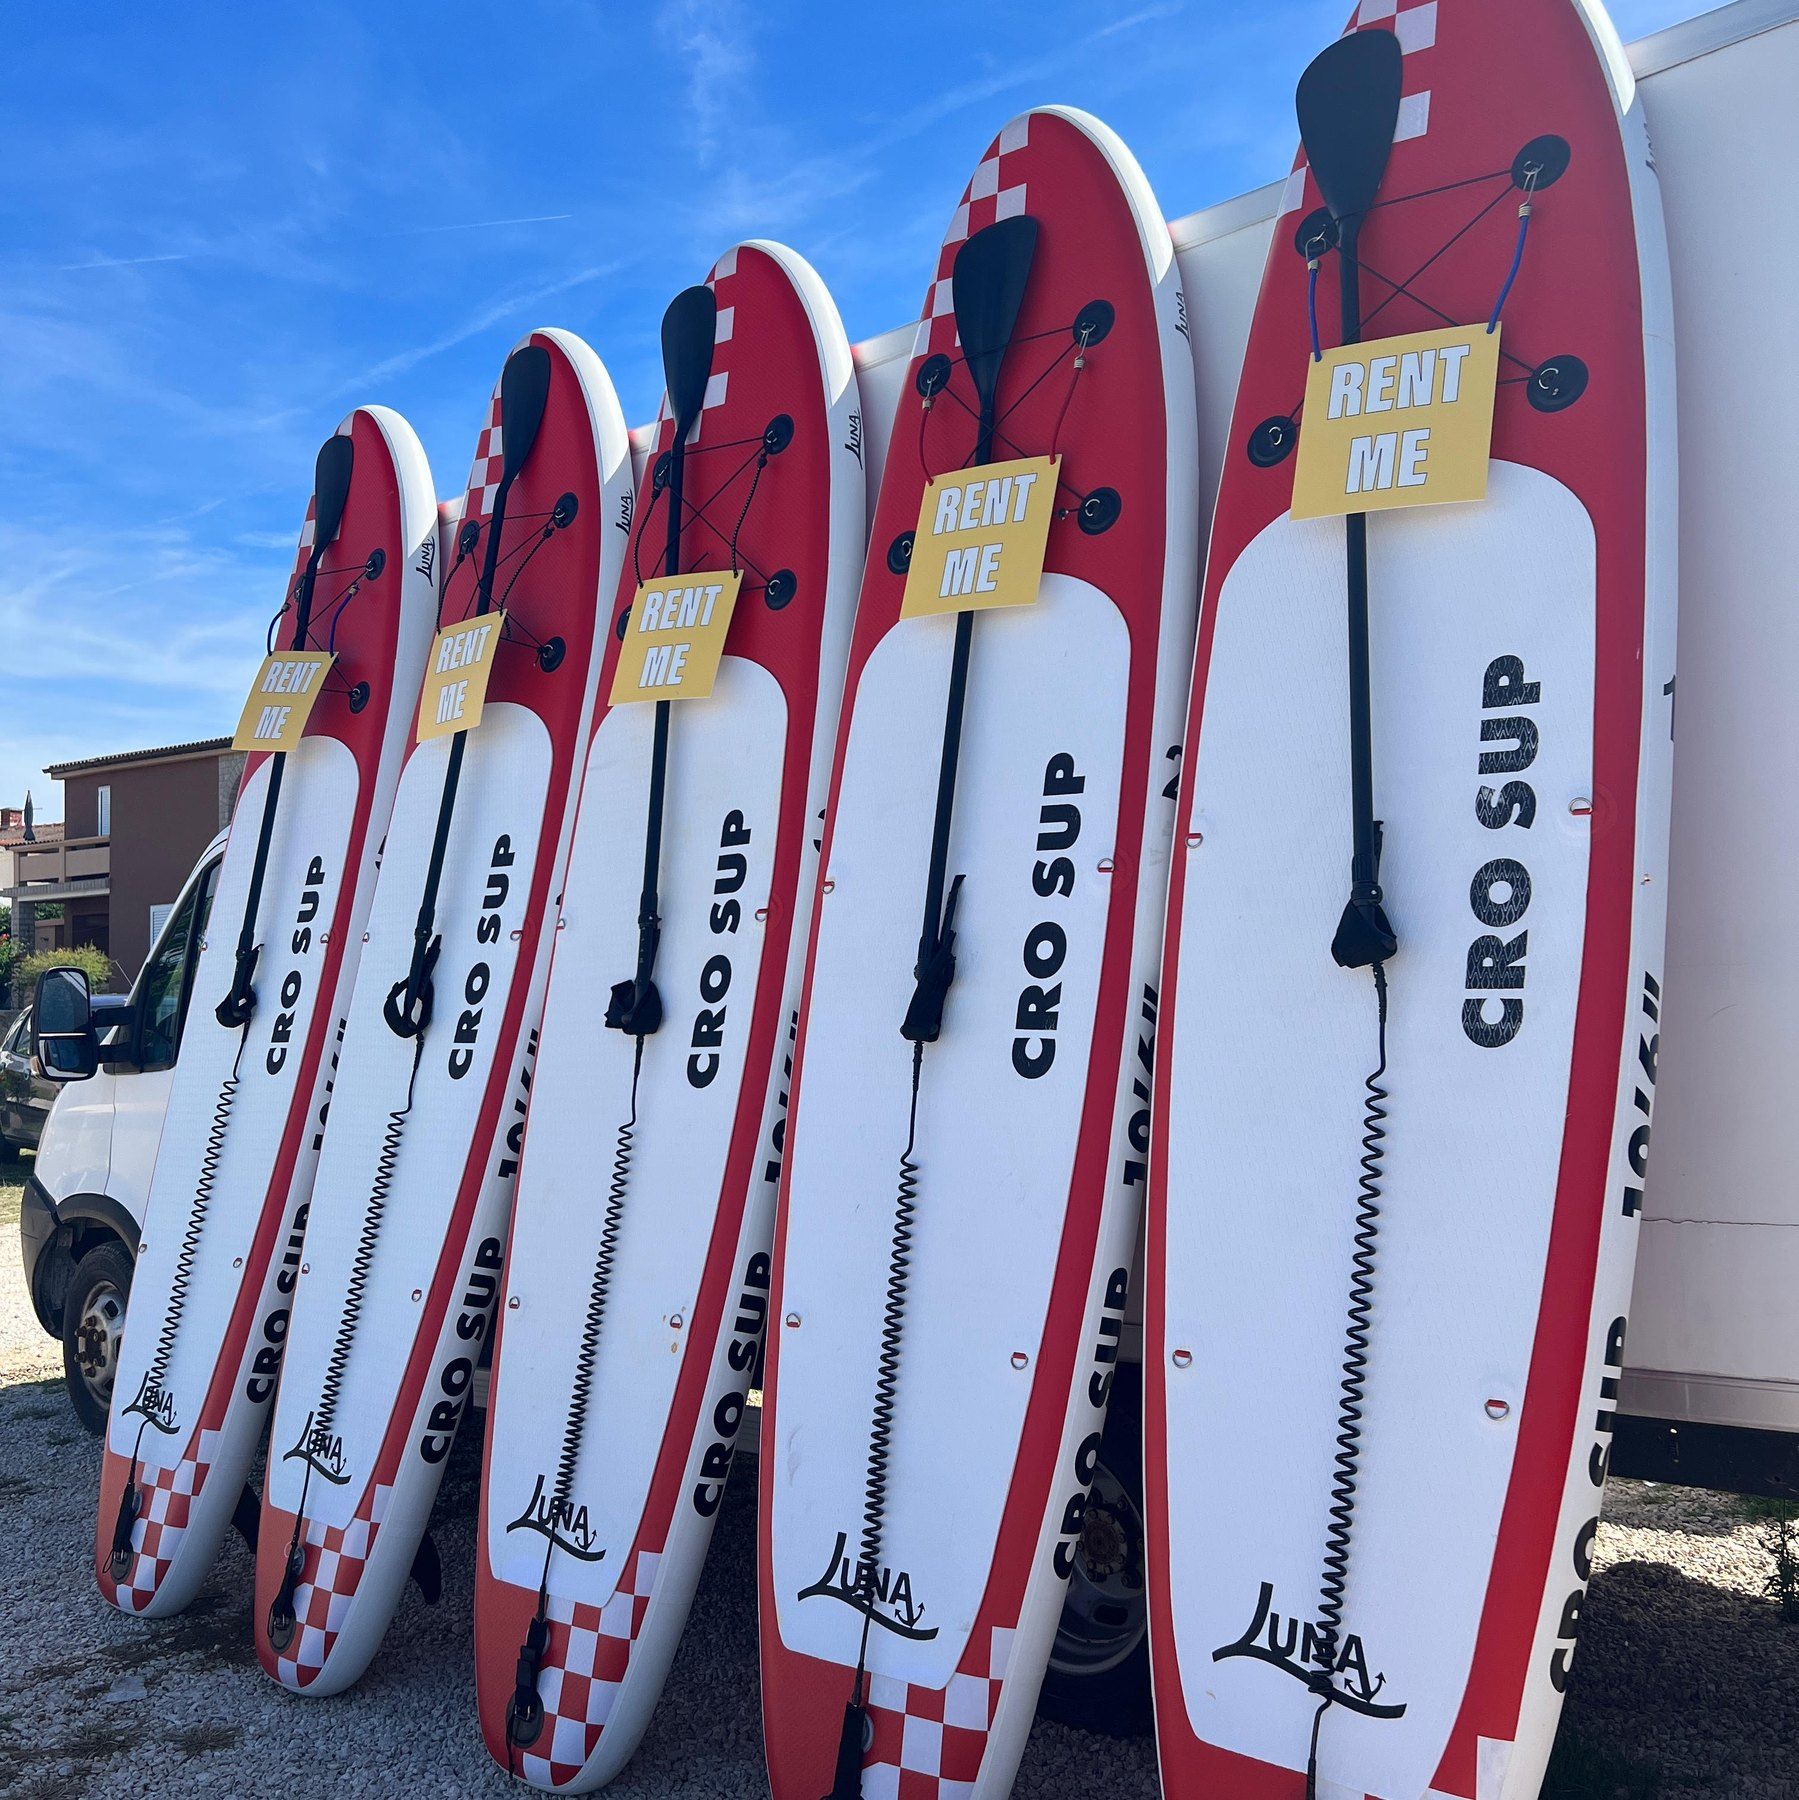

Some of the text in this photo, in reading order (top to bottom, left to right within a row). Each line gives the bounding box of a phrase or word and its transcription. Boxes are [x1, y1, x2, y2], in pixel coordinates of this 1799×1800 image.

[1327, 344, 1470, 420] RENT
[844, 406, 863, 471] LUNA
[1345, 428, 1431, 494] ME
[615, 488, 634, 537] LUNA
[932, 473, 1038, 536] RENT
[415, 535, 436, 588] LUNA
[939, 543, 1003, 598] ME
[638, 584, 724, 633] RENT
[260, 660, 322, 694] RENT
[435, 624, 493, 675] RENT
[638, 643, 691, 688] ME
[253, 705, 292, 739] ME
[435, 679, 468, 725] ME
[1461, 654, 1541, 1049] CRO SUP
[687, 809, 752, 1089] CRO SUP
[1012, 752, 1086, 1080] CRO SUP
[266, 855, 325, 1076] CRO SUP
[448, 834, 515, 1080] CRO SUP
[246, 1308, 290, 1404] CRO
[420, 1237, 503, 1464] CRO SUP
[693, 1251, 771, 1518] CRO SUP
[506, 1474, 607, 1562] LUNA
[797, 1531, 939, 1641] LUNA
